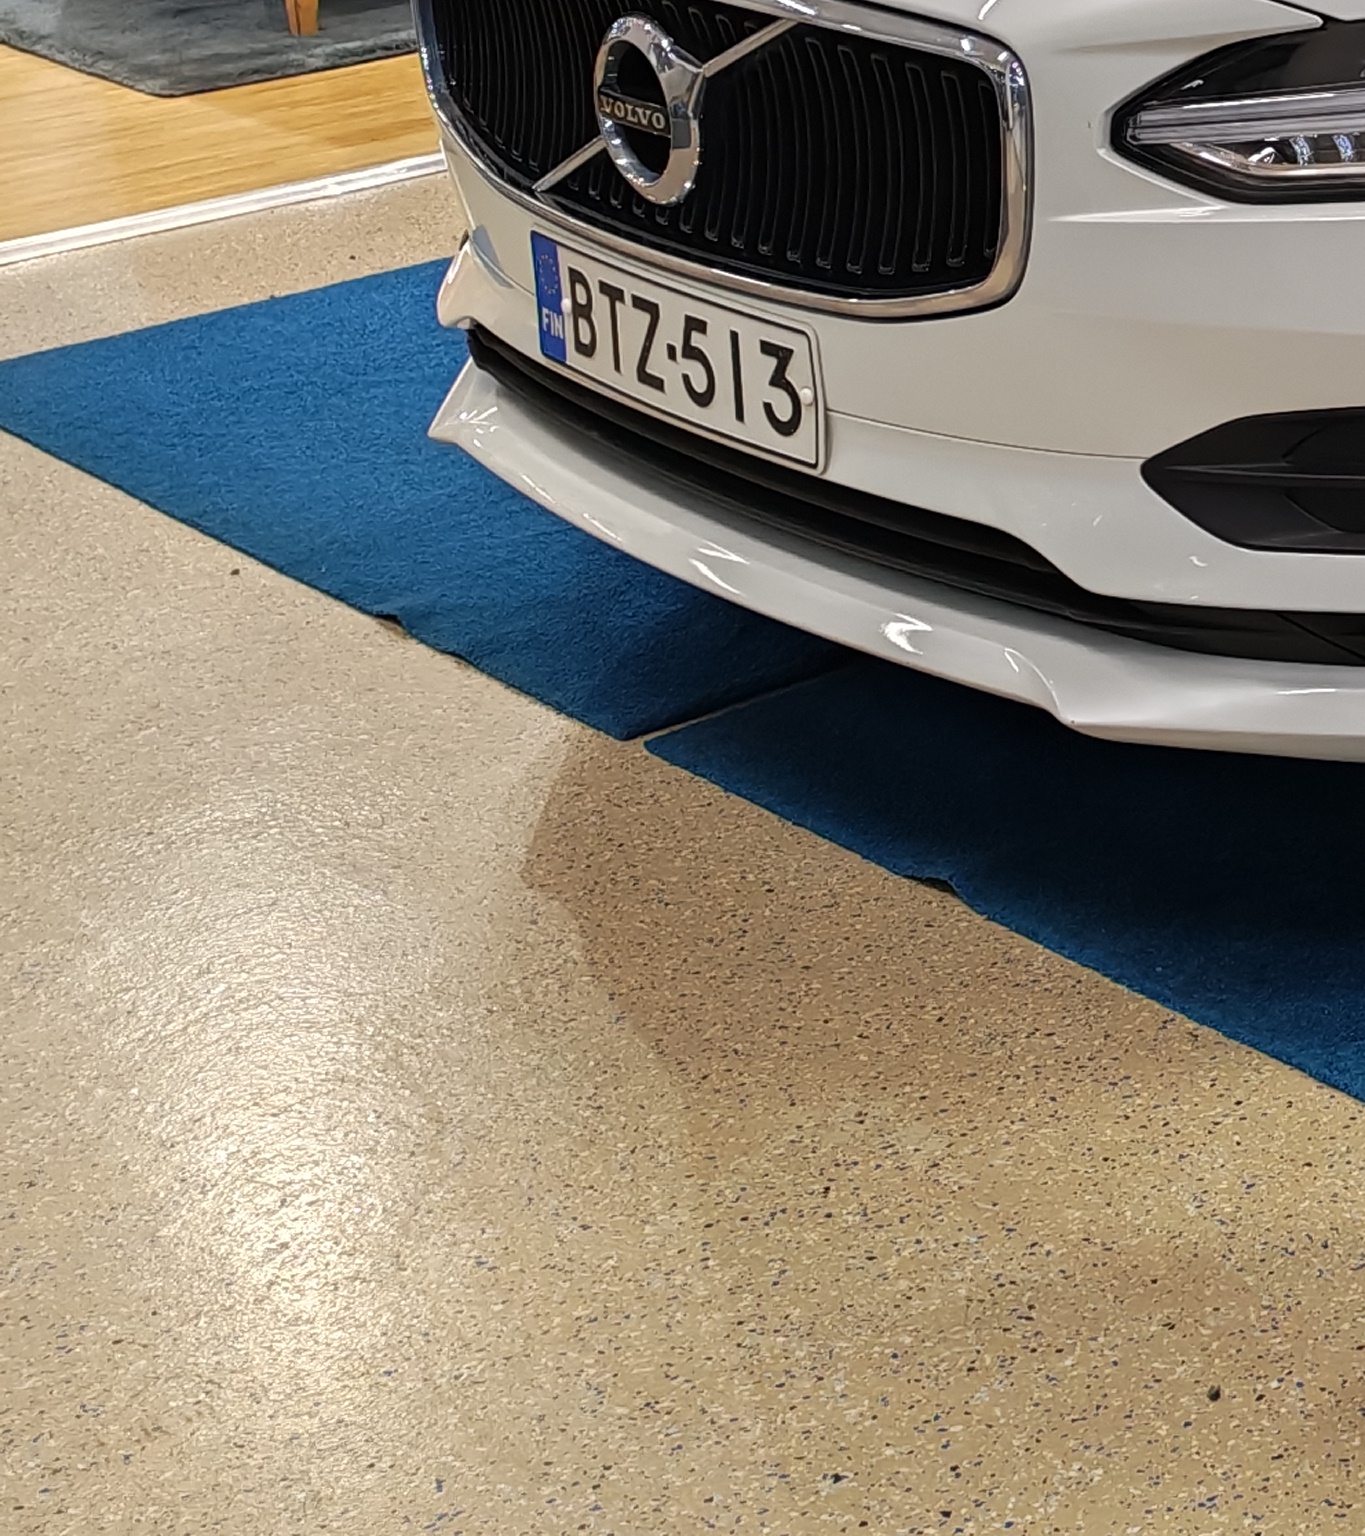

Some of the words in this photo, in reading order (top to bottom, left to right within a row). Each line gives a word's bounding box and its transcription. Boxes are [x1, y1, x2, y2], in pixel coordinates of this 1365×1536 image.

[598, 93, 667, 131] VOLVO
[541, 306, 565, 341] FIN
[567, 265, 803, 438] BTZ-513
